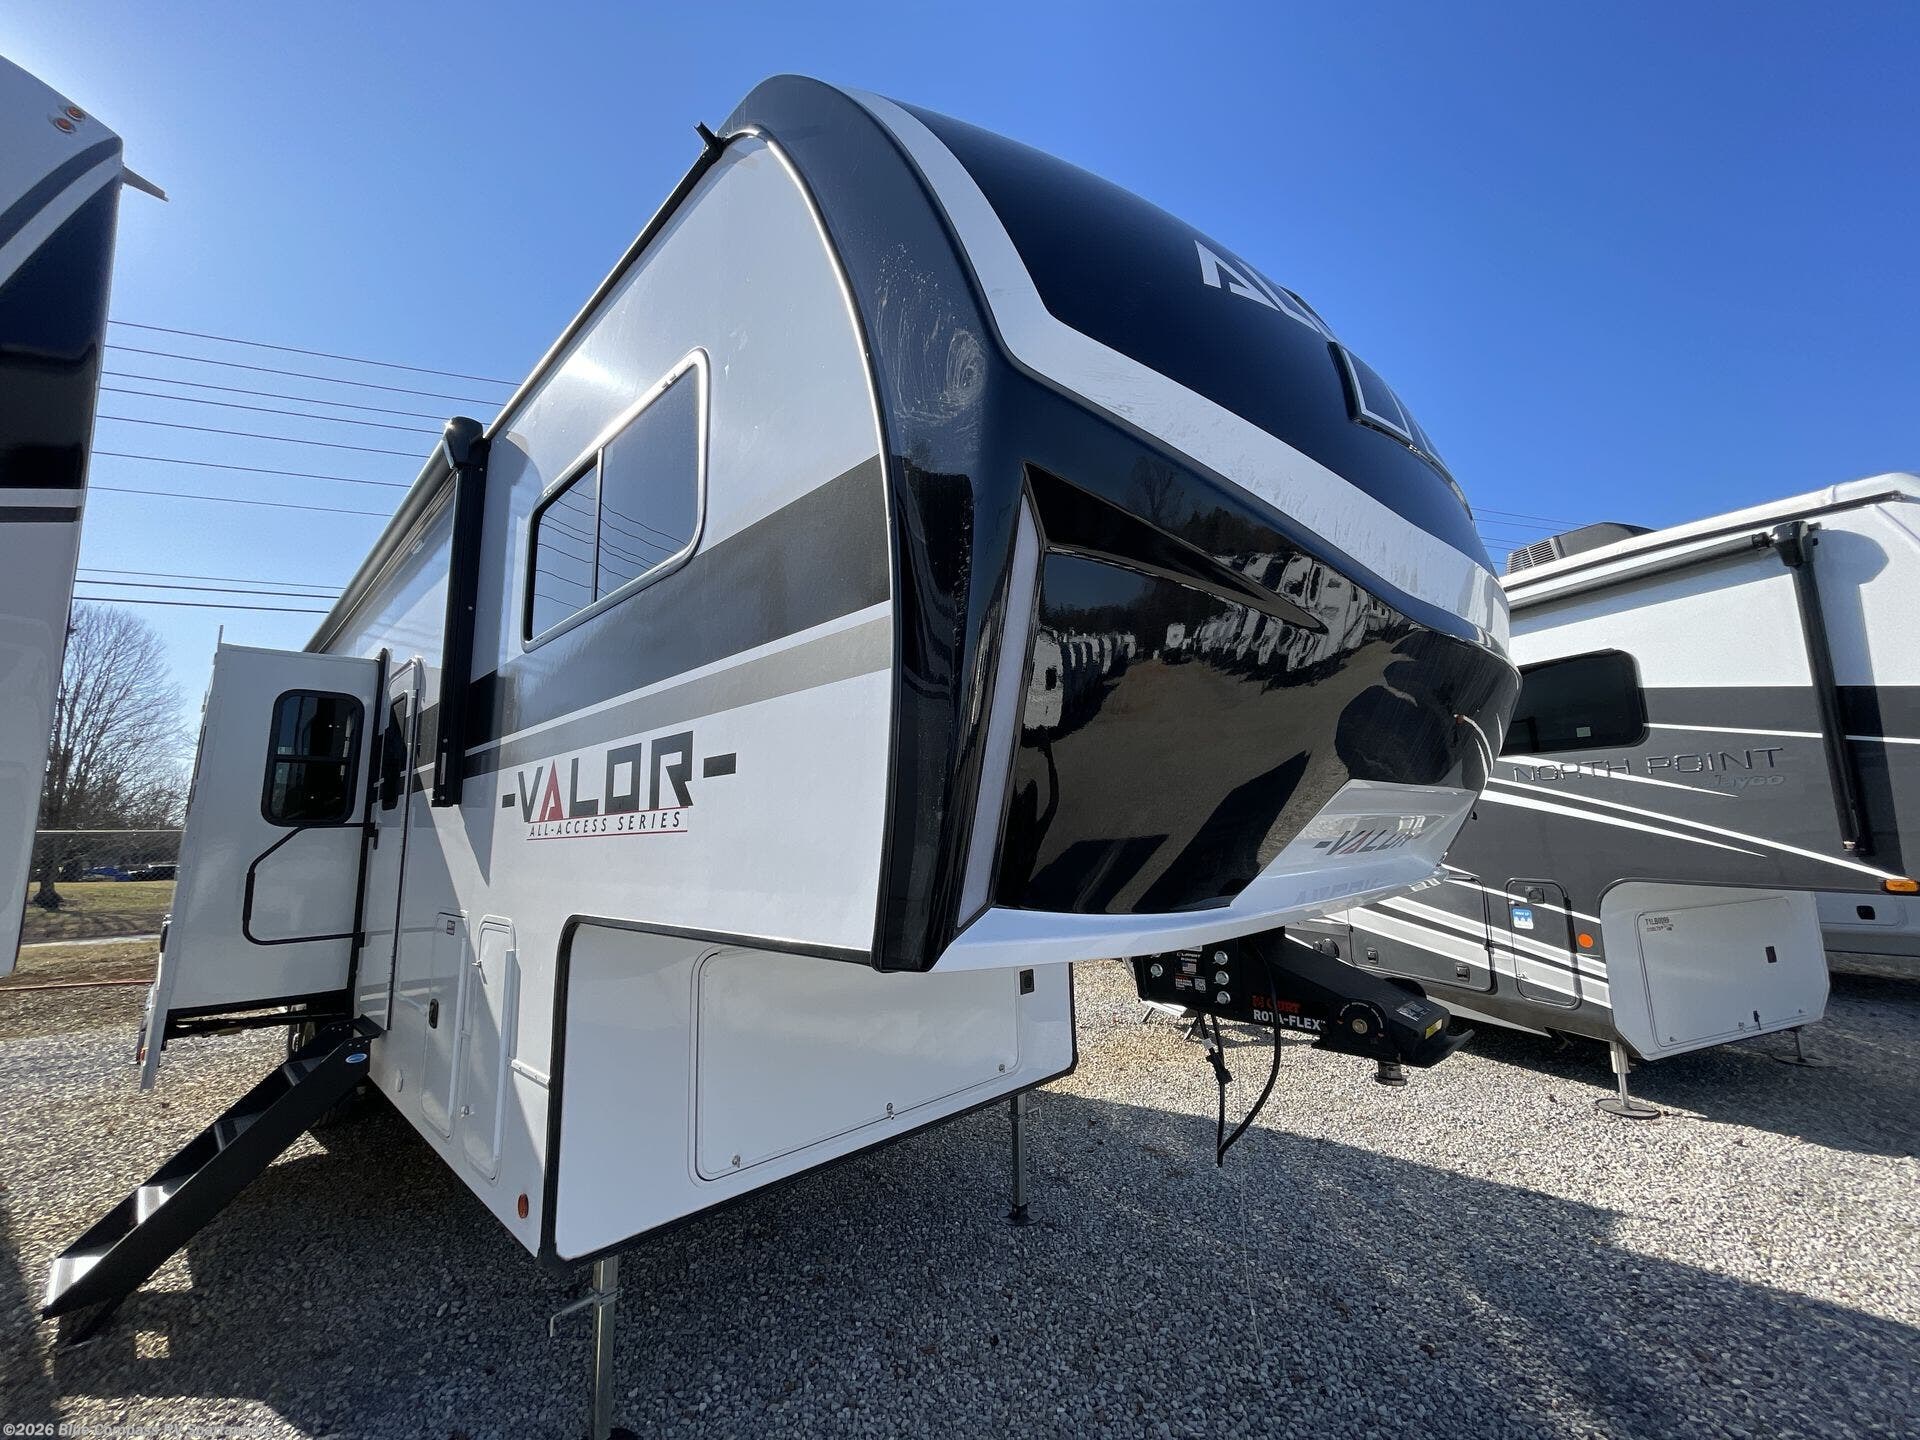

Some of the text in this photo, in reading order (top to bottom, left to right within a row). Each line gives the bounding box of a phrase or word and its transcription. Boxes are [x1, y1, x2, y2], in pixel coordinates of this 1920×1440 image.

[518, 730, 694, 822] VALOR
[1512, 747, 1784, 783] NORTH POINT
[529, 810, 681, 838] ALL-ACCESS SERIES
